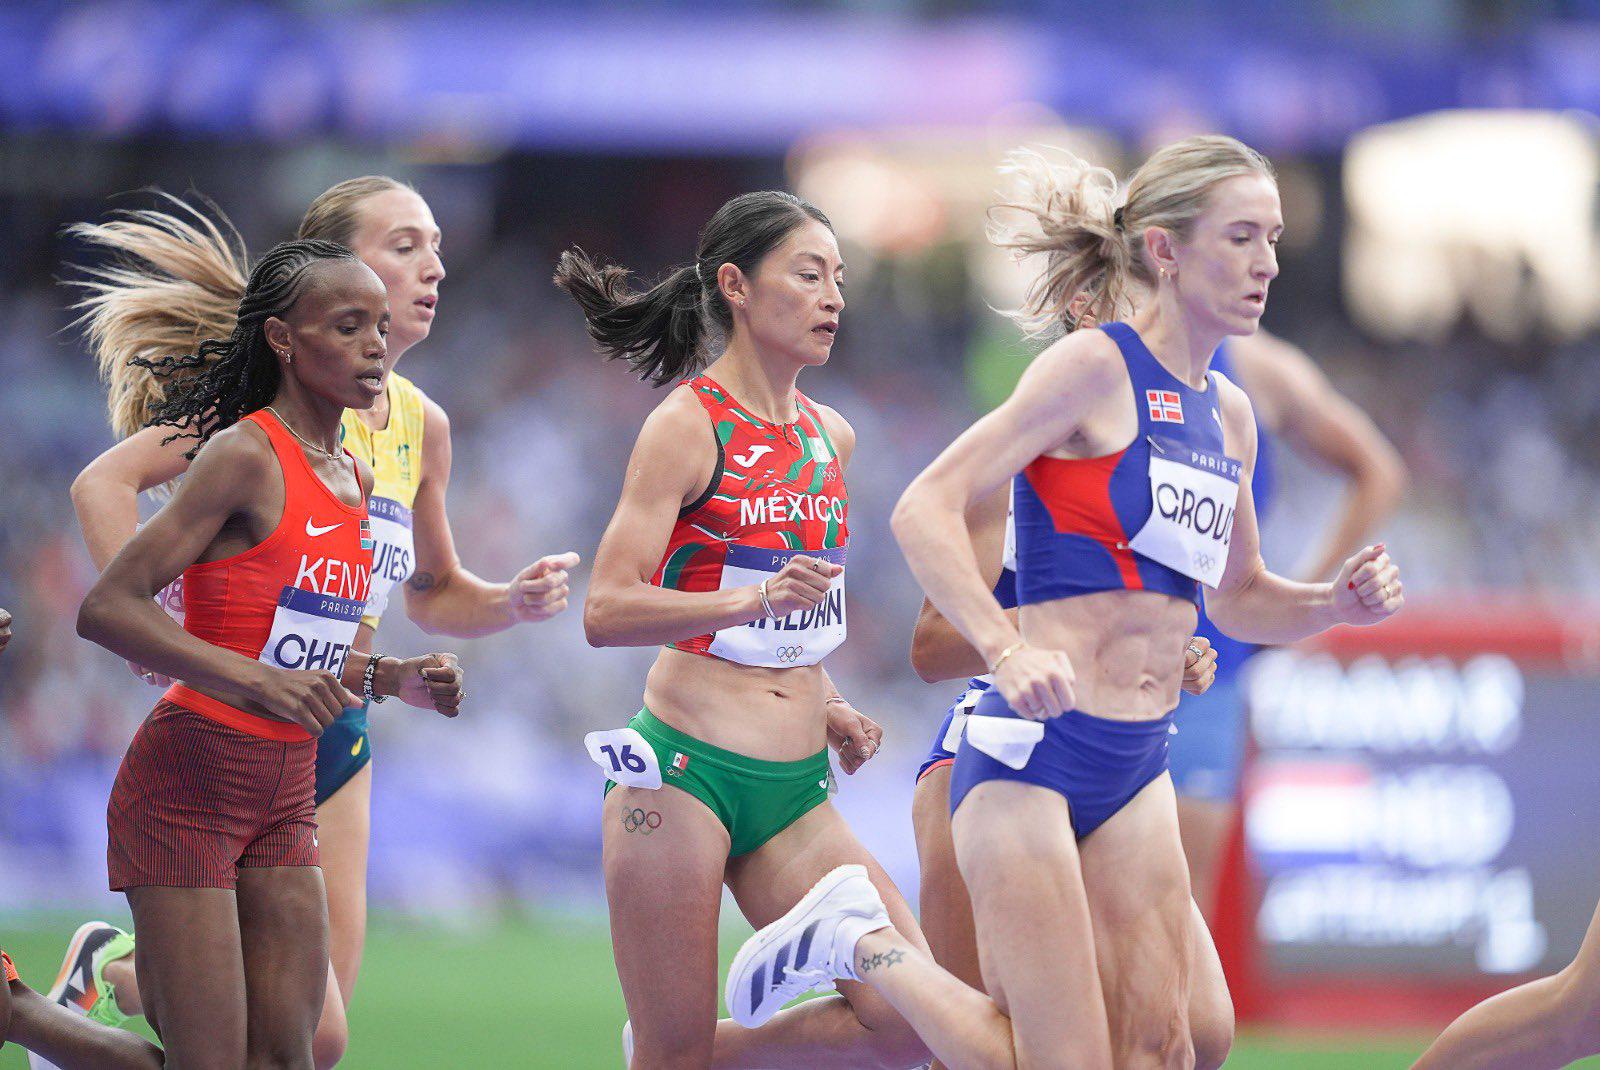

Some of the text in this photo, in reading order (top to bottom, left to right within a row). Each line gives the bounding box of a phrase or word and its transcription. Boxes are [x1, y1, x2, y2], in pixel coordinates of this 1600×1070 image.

[1191, 451, 1227, 473] PARIS
[740, 490, 844, 527] MÉXICO
[293, 554, 372, 602] KENY
[320, 600, 350, 615] PARIS
[600, 744, 646, 773] 16
